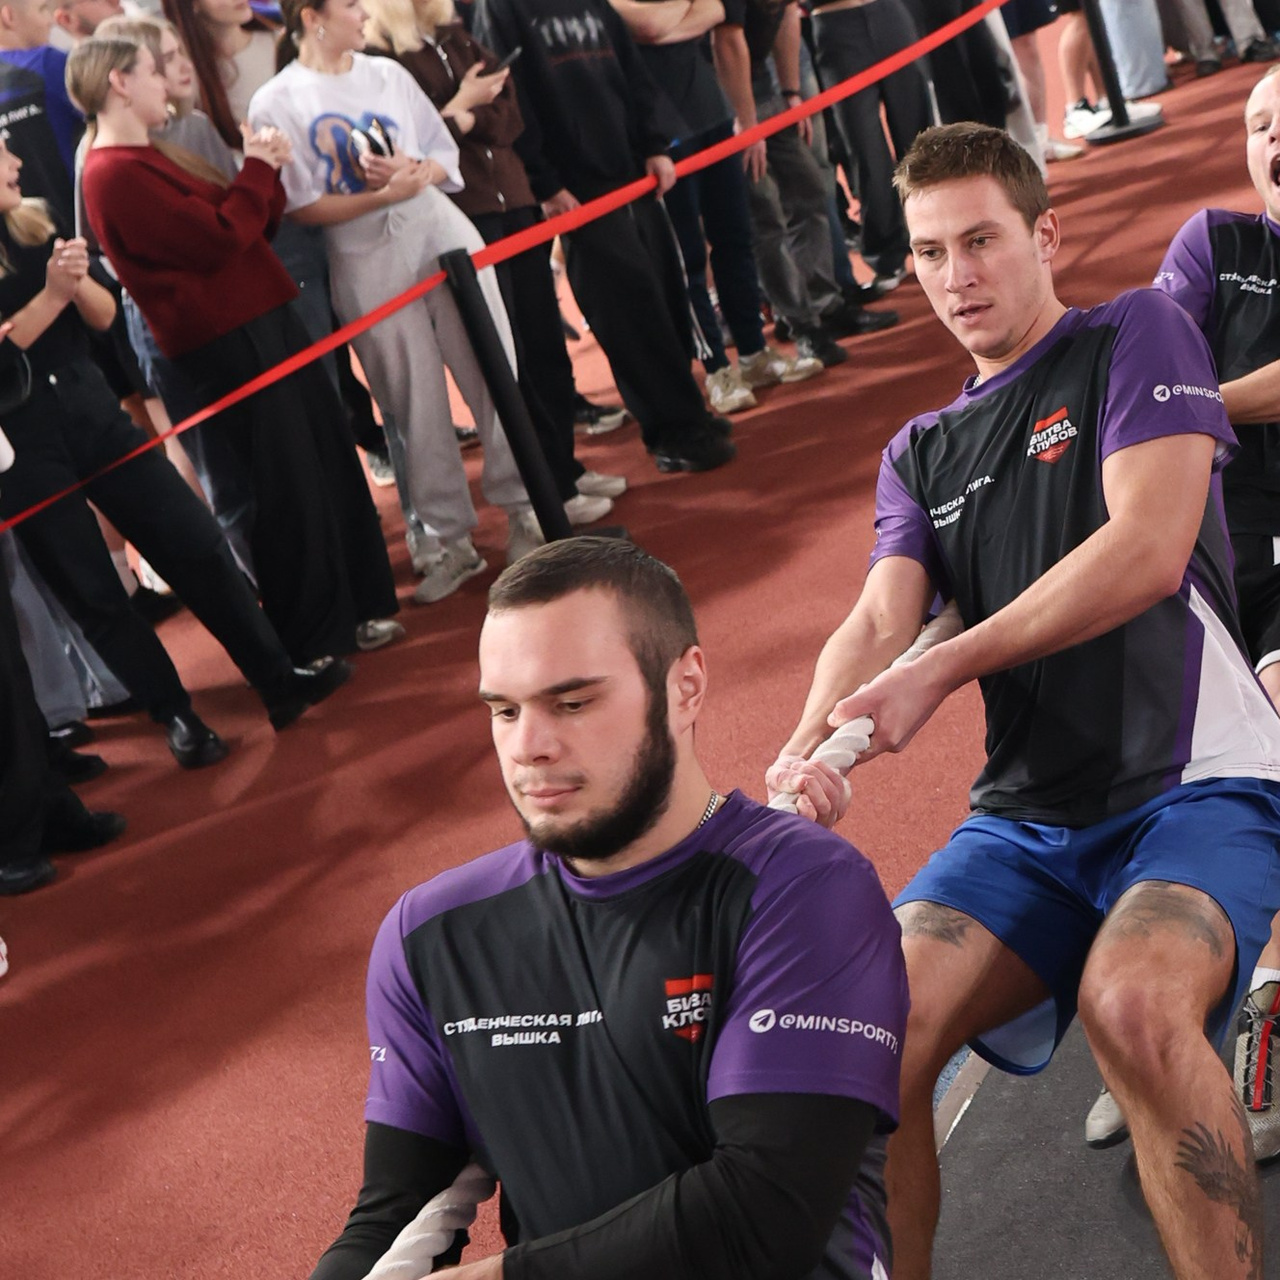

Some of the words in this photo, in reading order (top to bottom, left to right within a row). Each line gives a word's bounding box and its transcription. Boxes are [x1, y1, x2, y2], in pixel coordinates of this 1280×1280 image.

[1027, 426, 1078, 457] КЛУБОВ
[1030, 419, 1072, 446] БИТВА
[491, 1031, 561, 1047] ВЫШКА
[779, 1014, 898, 1054] @MINSPORT71
